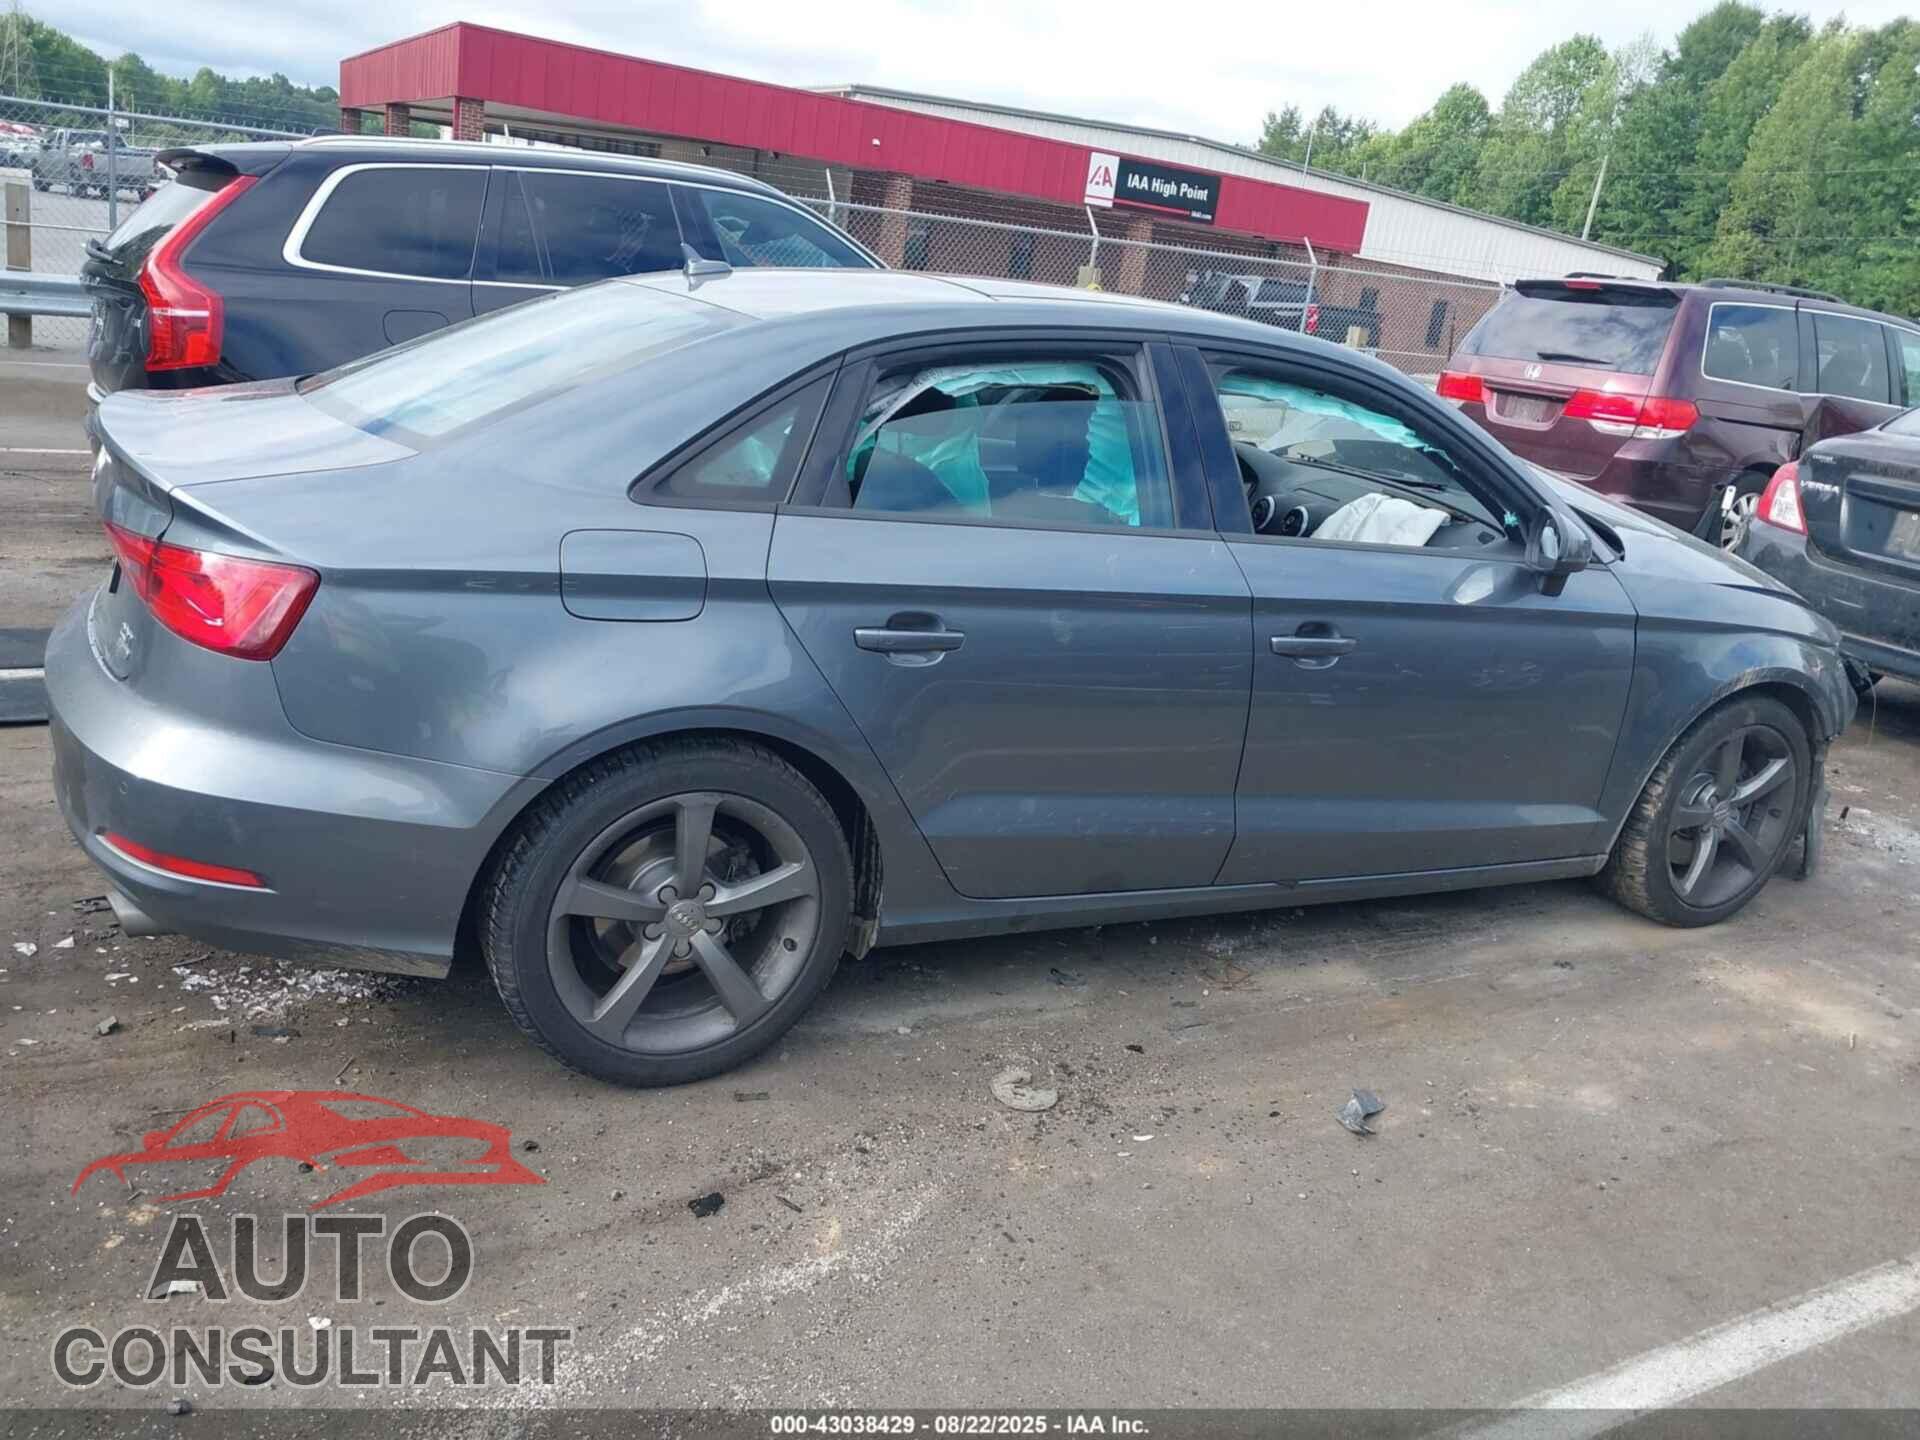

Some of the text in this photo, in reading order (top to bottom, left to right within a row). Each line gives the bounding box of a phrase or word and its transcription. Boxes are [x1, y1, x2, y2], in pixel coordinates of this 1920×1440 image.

[1127, 173, 1208, 201] IAA High Point
